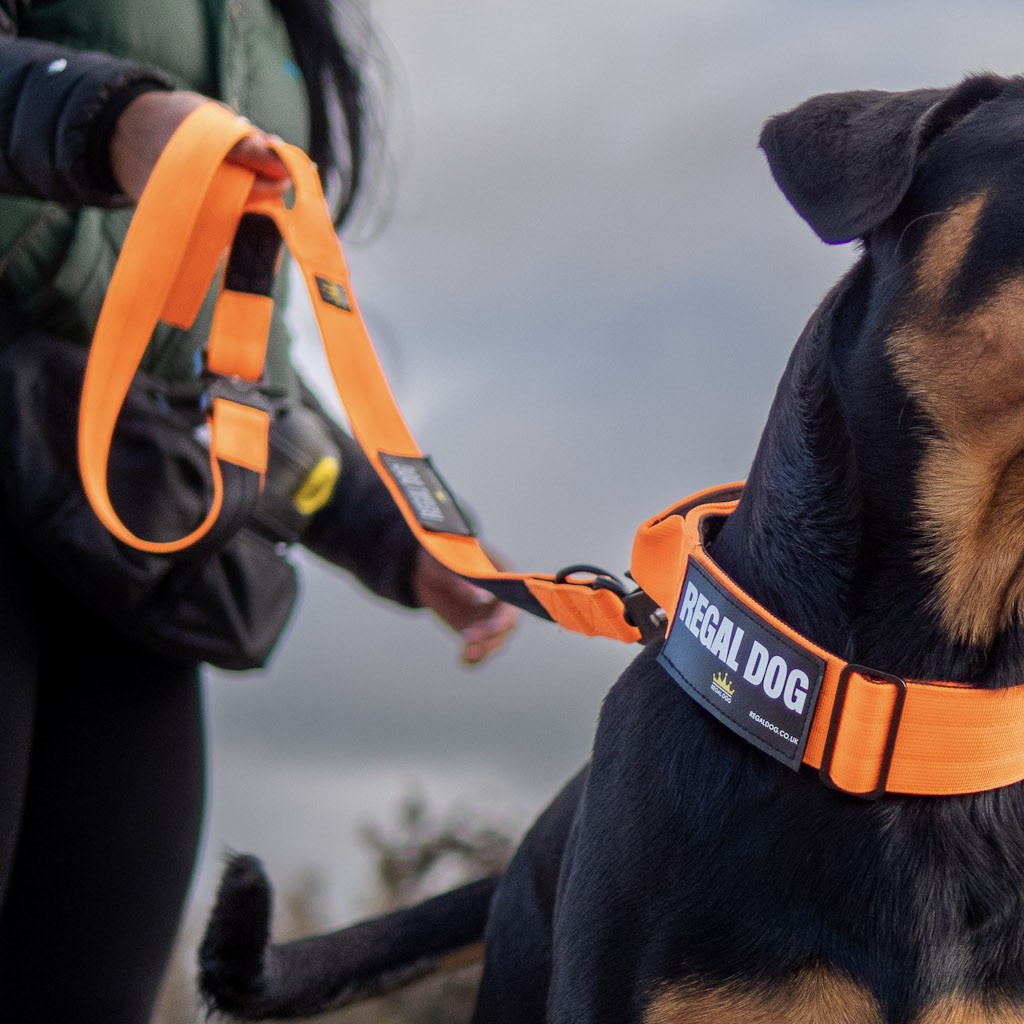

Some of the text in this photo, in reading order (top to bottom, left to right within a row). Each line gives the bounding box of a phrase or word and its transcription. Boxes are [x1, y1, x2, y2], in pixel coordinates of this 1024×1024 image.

[679, 581, 809, 714] REGAL DOG
[748, 710, 799, 745] REGALDOG.CO.UK
